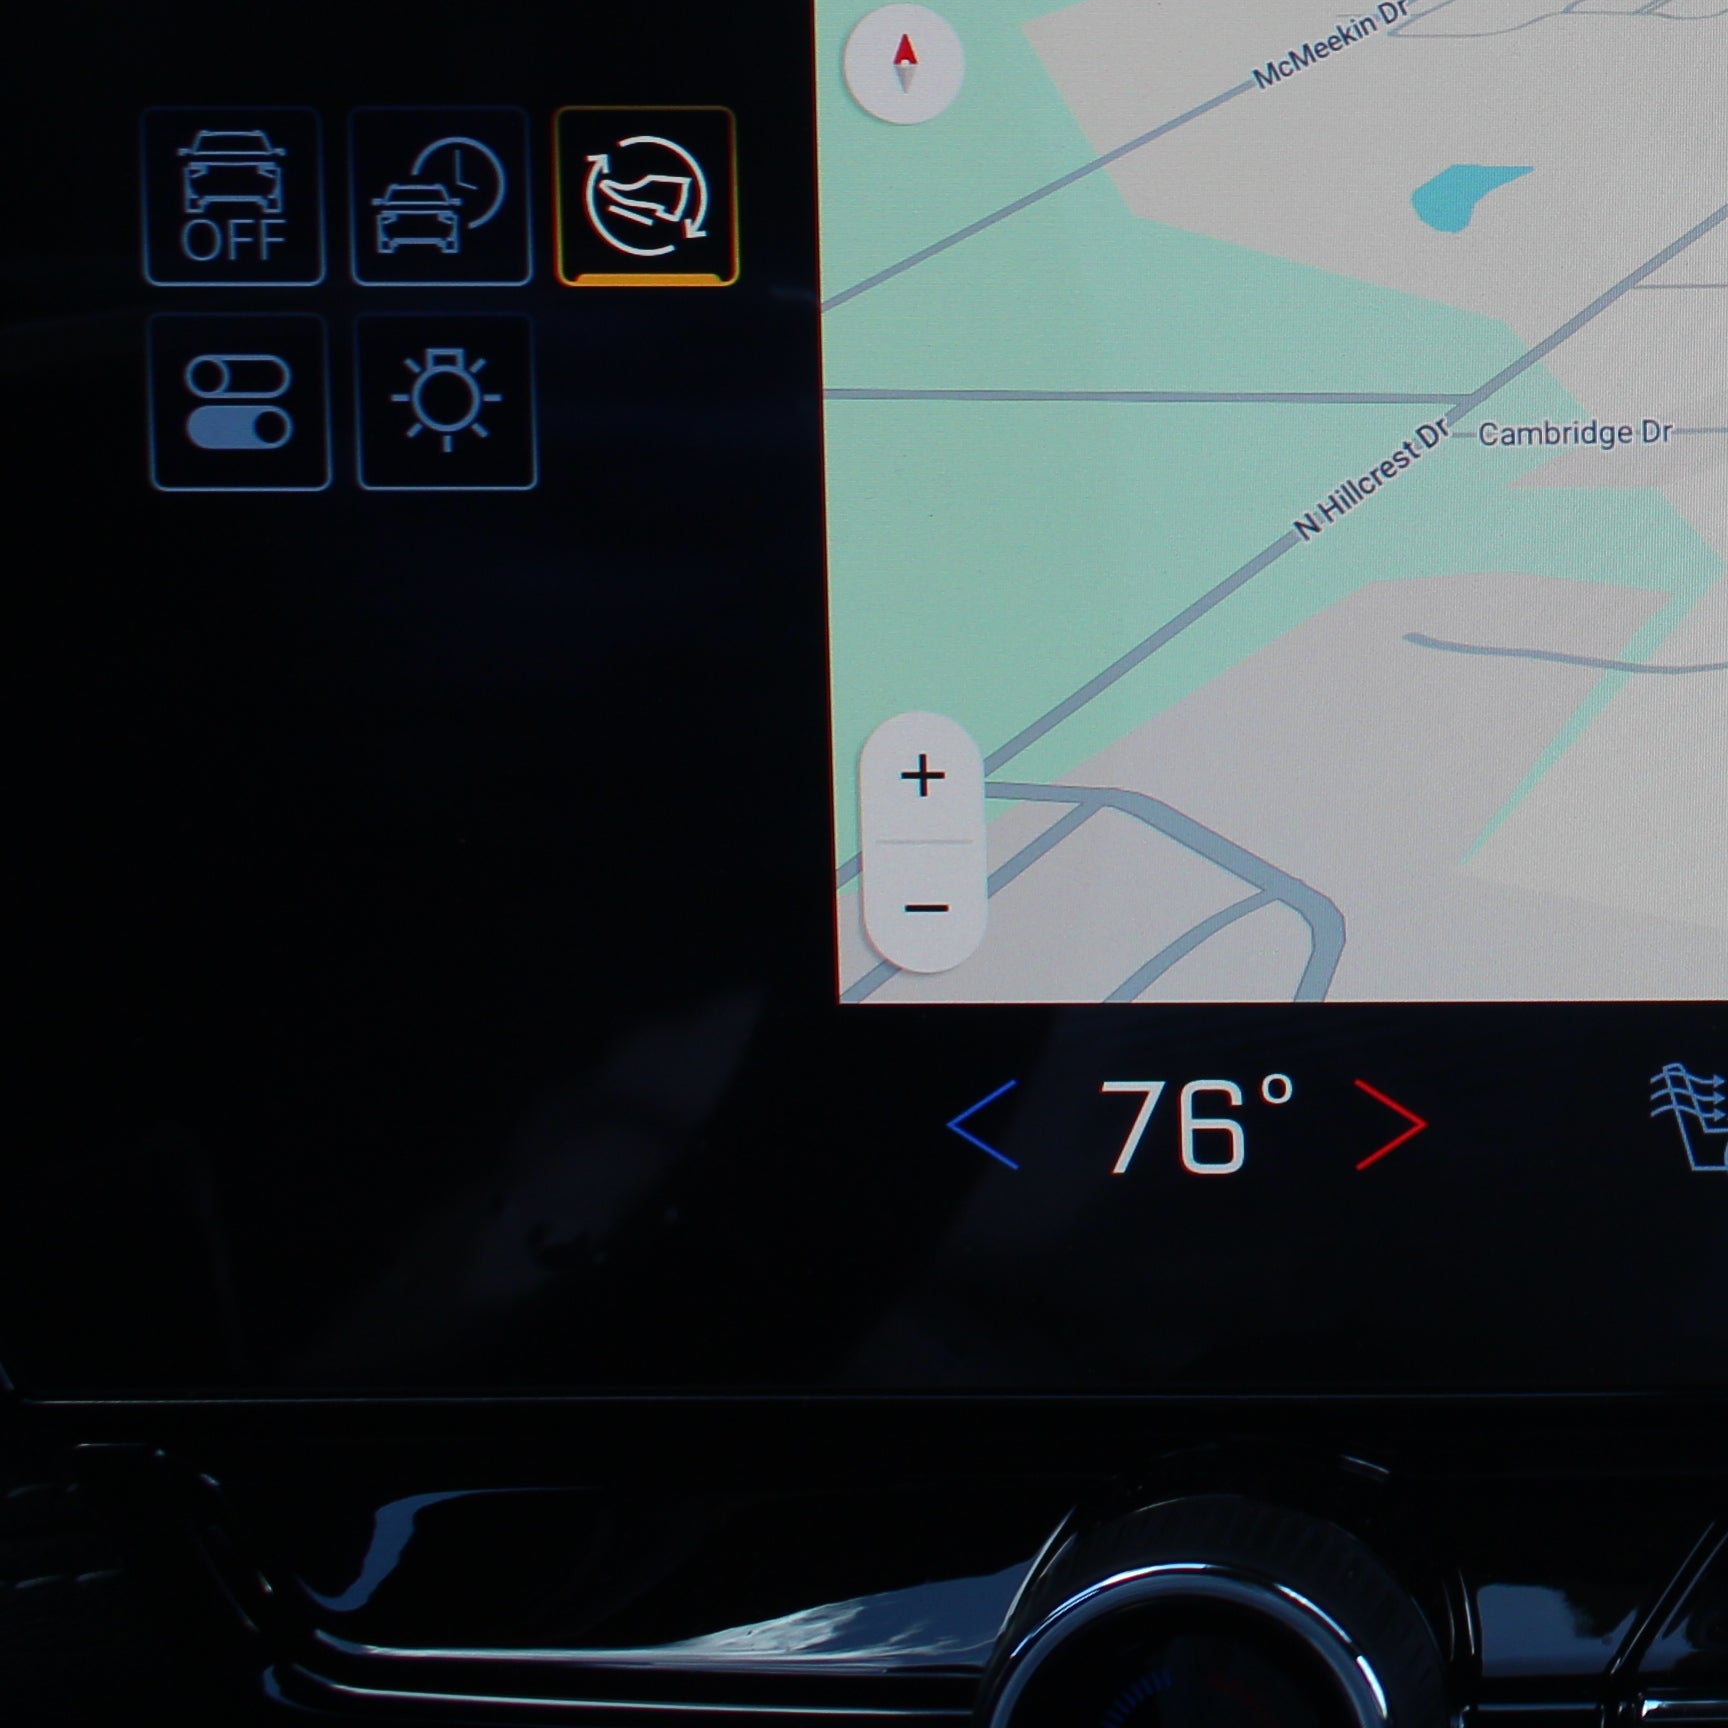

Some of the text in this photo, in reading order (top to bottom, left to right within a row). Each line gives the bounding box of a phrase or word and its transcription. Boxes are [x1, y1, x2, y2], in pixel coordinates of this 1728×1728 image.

[1252, 20, 1377, 90] McMeekin
[181, 219, 286, 261] OFF
[1479, 419, 1672, 451] Cambridge Dr
[1293, 412, 1453, 543] N Hillcrest Dr
